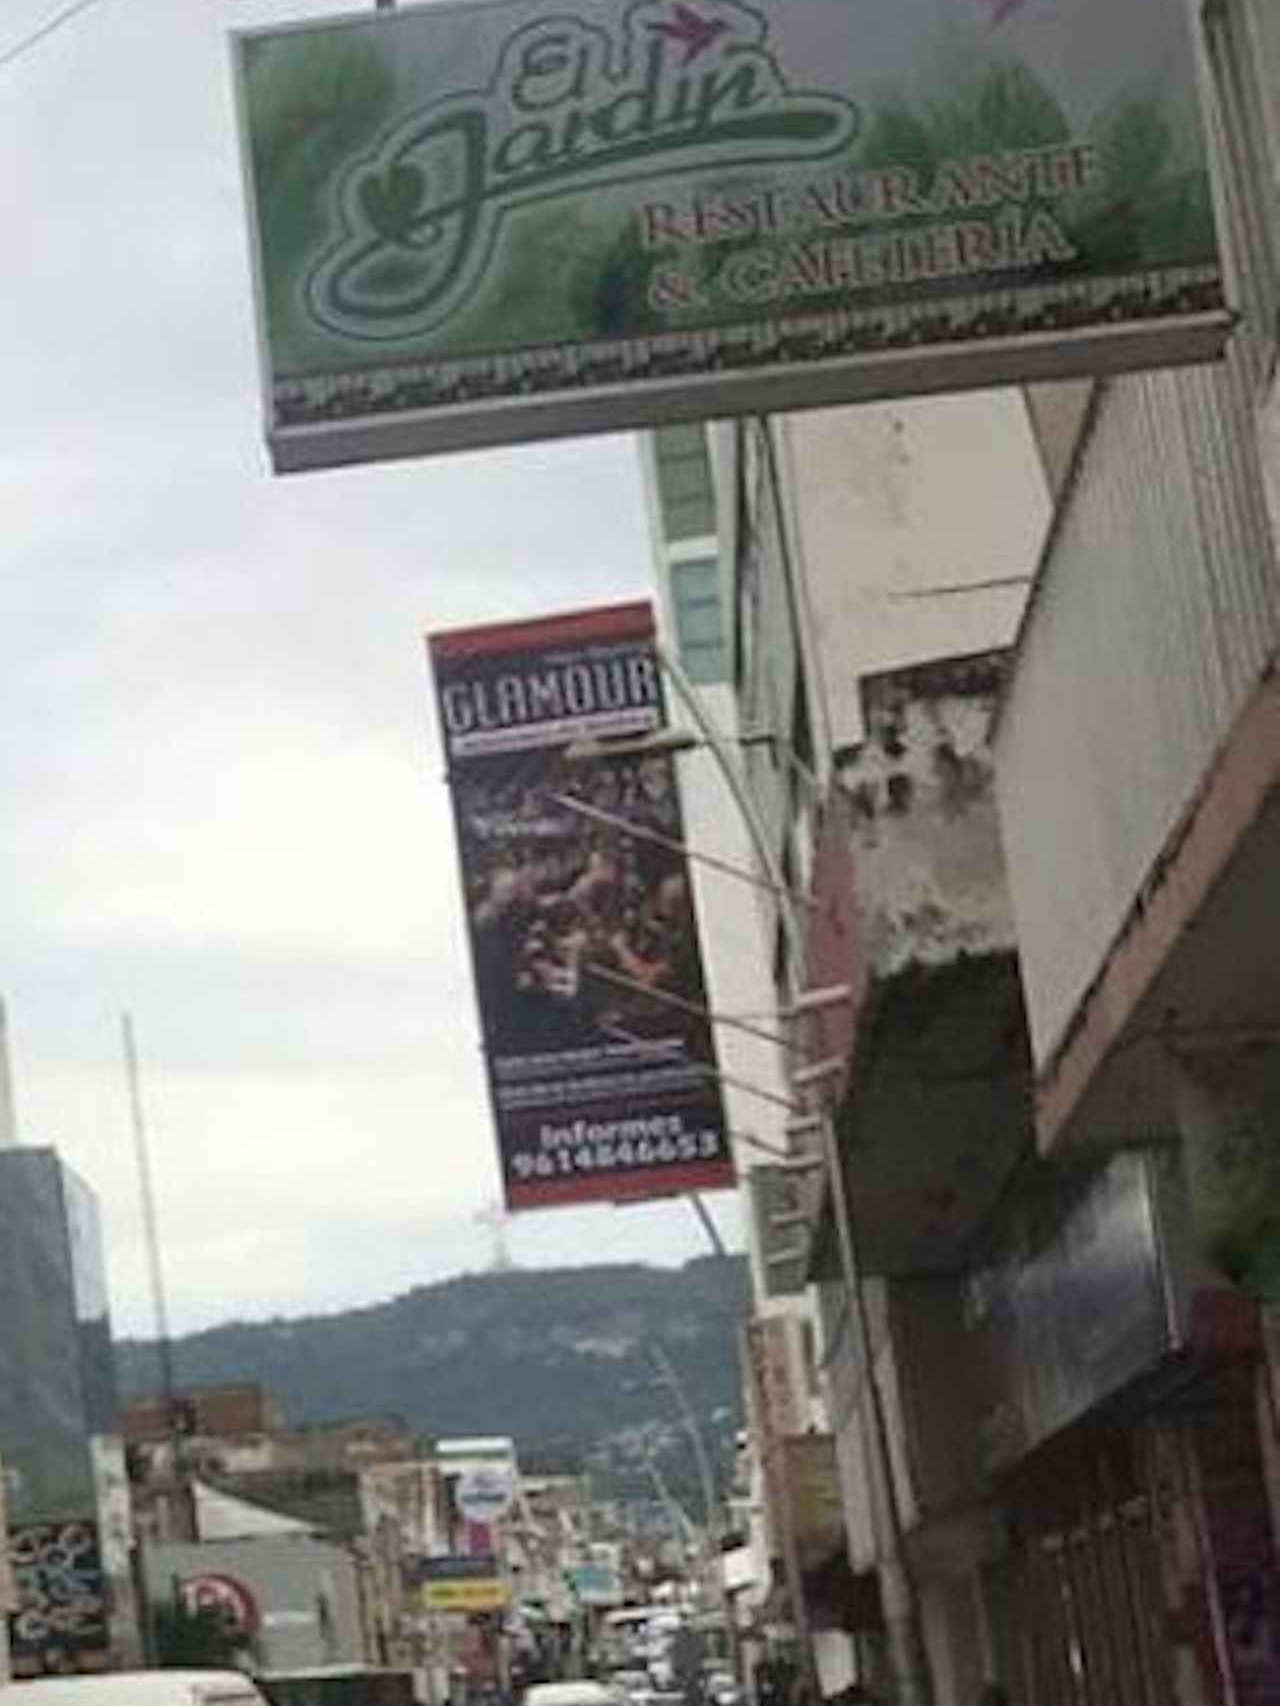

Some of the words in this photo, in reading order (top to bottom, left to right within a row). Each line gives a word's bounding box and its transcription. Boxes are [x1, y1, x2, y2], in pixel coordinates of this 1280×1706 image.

[512, 31, 588, 111] El
[643, 143, 1095, 247] RESTAURANTE
[648, 259, 708, 311] &
[442, 657, 658, 733] GLAMOUR
[540, 1113, 682, 1149] Informes
